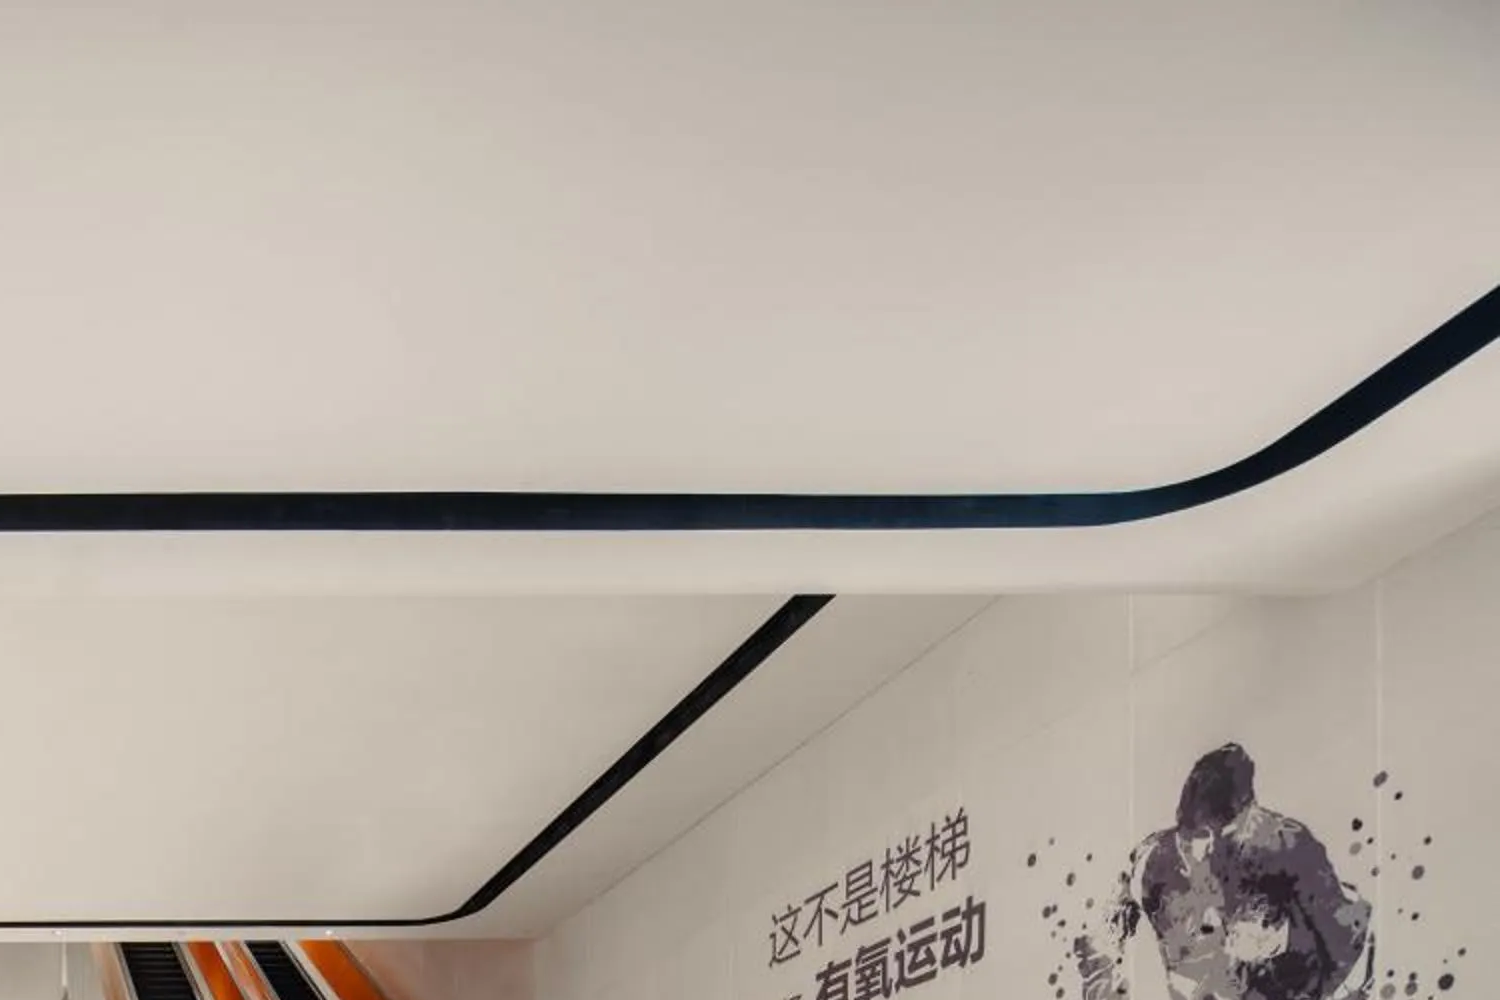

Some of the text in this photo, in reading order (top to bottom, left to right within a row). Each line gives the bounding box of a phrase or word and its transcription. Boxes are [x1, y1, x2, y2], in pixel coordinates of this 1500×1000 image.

[769, 807, 971, 968] 这不是楼梯
